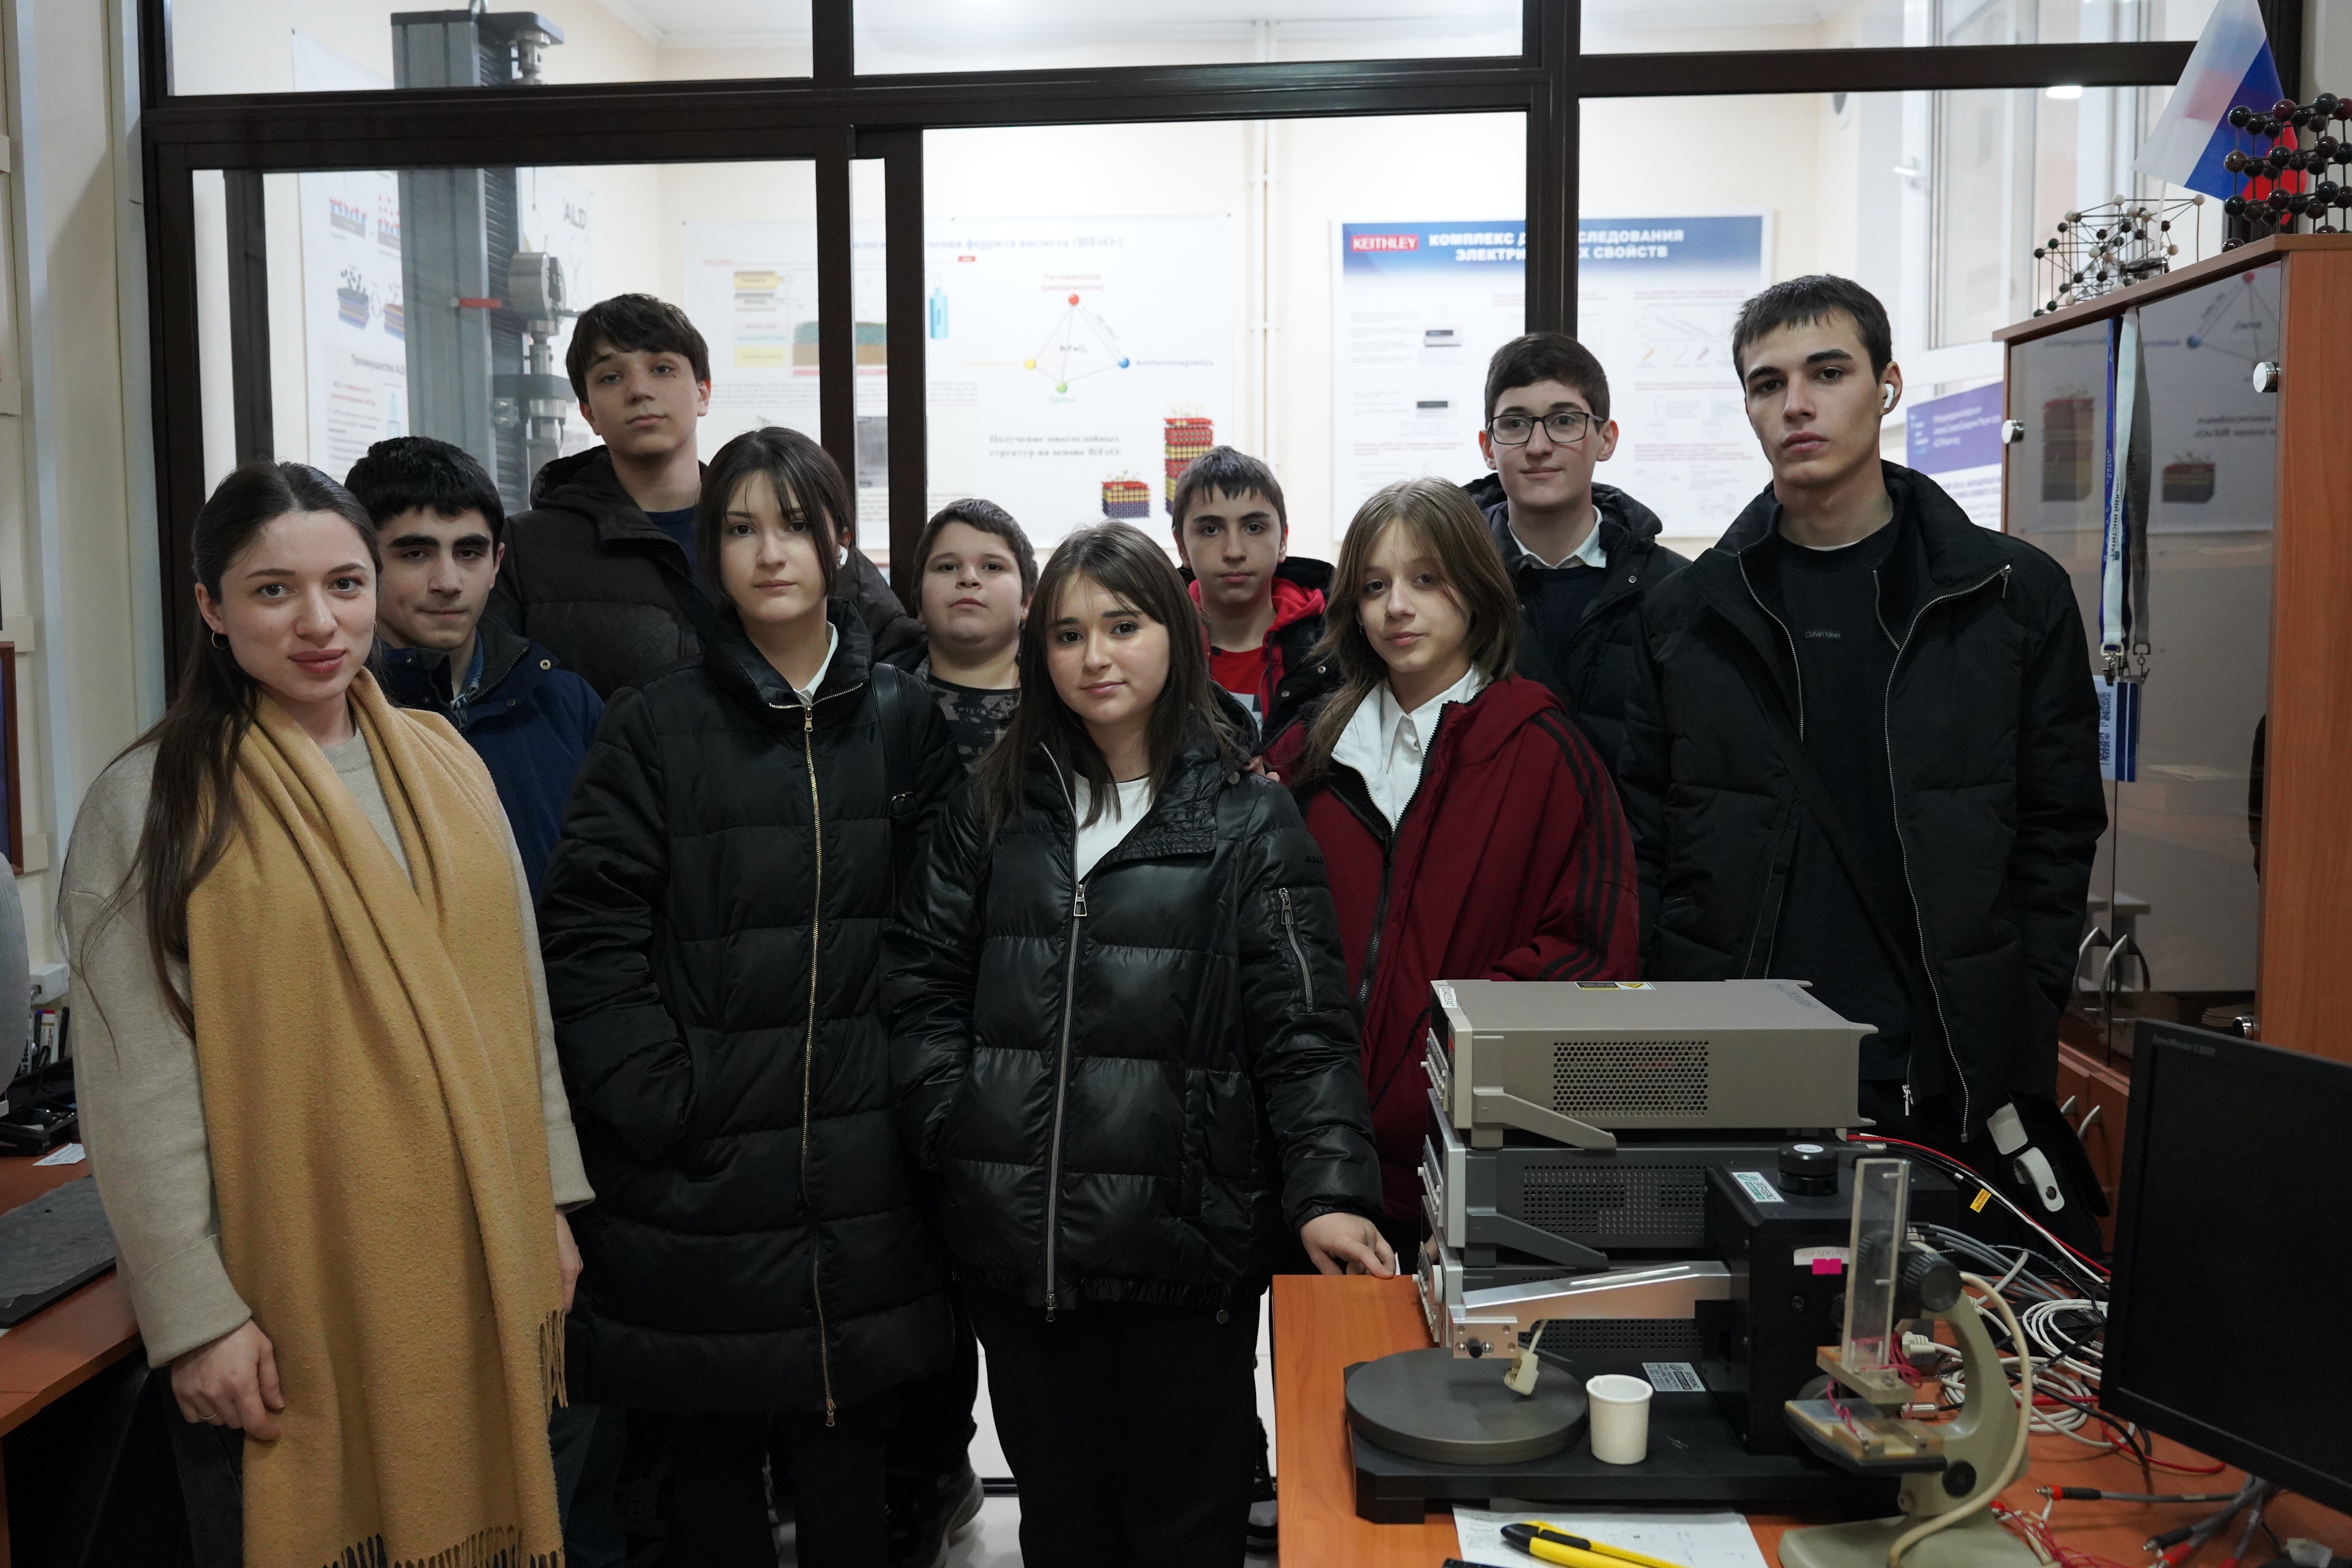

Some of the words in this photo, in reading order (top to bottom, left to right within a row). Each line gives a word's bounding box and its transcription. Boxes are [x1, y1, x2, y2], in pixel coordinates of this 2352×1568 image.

[966, 238, 1015, 250] феррита
[1019, 240, 1067, 250] висмута
[1353, 237, 1417, 250] KEITHLEY
[1429, 232, 1513, 246] КОМПЛЕКС
[1579, 229, 1684, 244] СЛЕДОВАНИЯ
[1594, 244, 1668, 259] СВОЙСТВ
[989, 435, 1043, 445] Получение
[989, 449, 1034, 459] структур
[2110, 514, 2119, 557] ИНСТИТУТ
